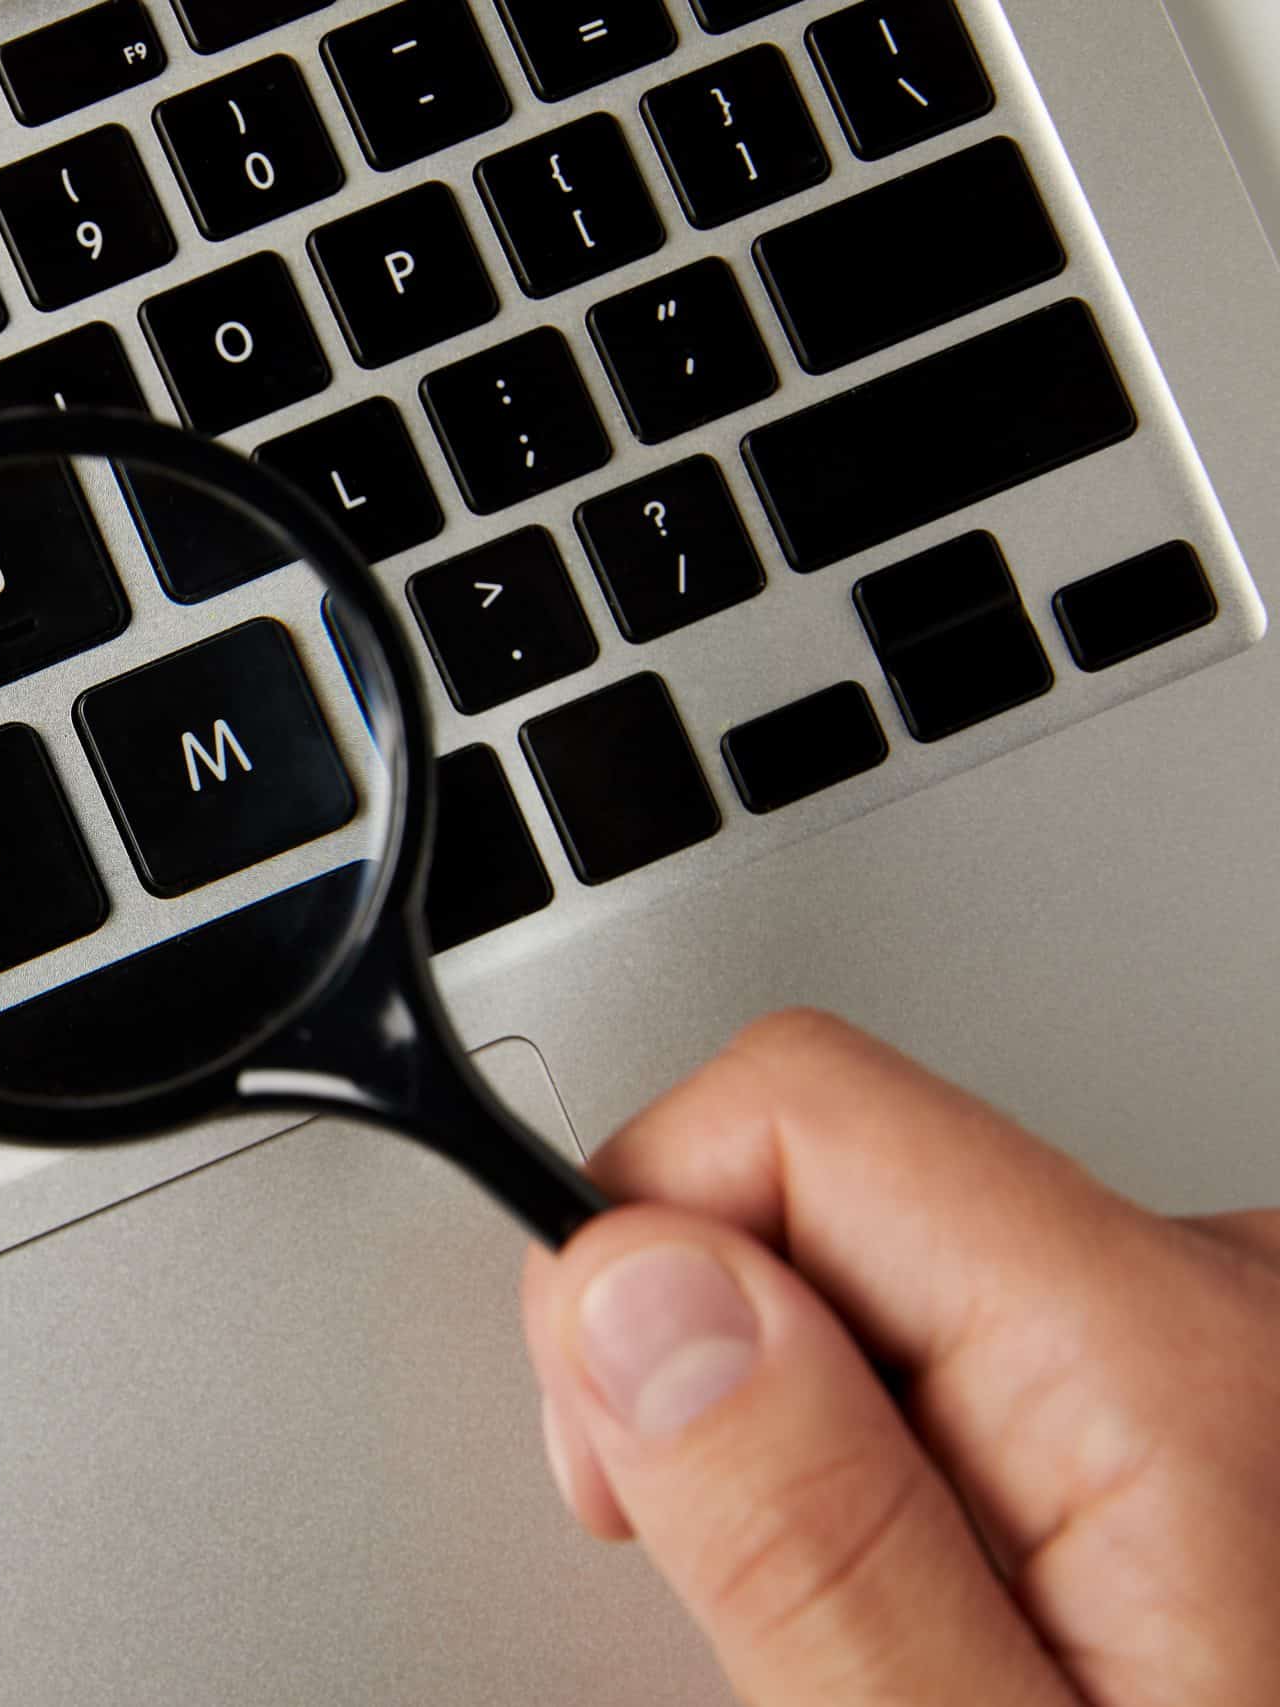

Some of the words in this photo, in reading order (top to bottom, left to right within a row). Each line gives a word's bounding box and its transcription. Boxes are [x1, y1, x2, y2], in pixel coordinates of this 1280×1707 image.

[578, 19, 608, 42] =
[123, 42, 147, 65] F9
[419, 94, 435, 104] -
[710, 88, 733, 127] }
[898, 77, 929, 107] \
[228, 100, 246, 135] )
[245, 151, 275, 190] 0
[549, 154, 573, 193] {
[735, 142, 758, 181] ]
[61, 168, 80, 203] (
[76, 221, 103, 260] 9
[572, 209, 595, 248] [
[384, 250, 415, 294] P
[215, 321, 253, 363] O
[496, 379, 511, 405] :
[519, 434, 535, 468] ;
[331, 470, 367, 509] L
[643, 501, 666, 538] ?
[679, 554, 686, 594] /
[474, 582, 503, 609] >
[511, 649, 522, 660] .
[181, 719, 253, 792] M
